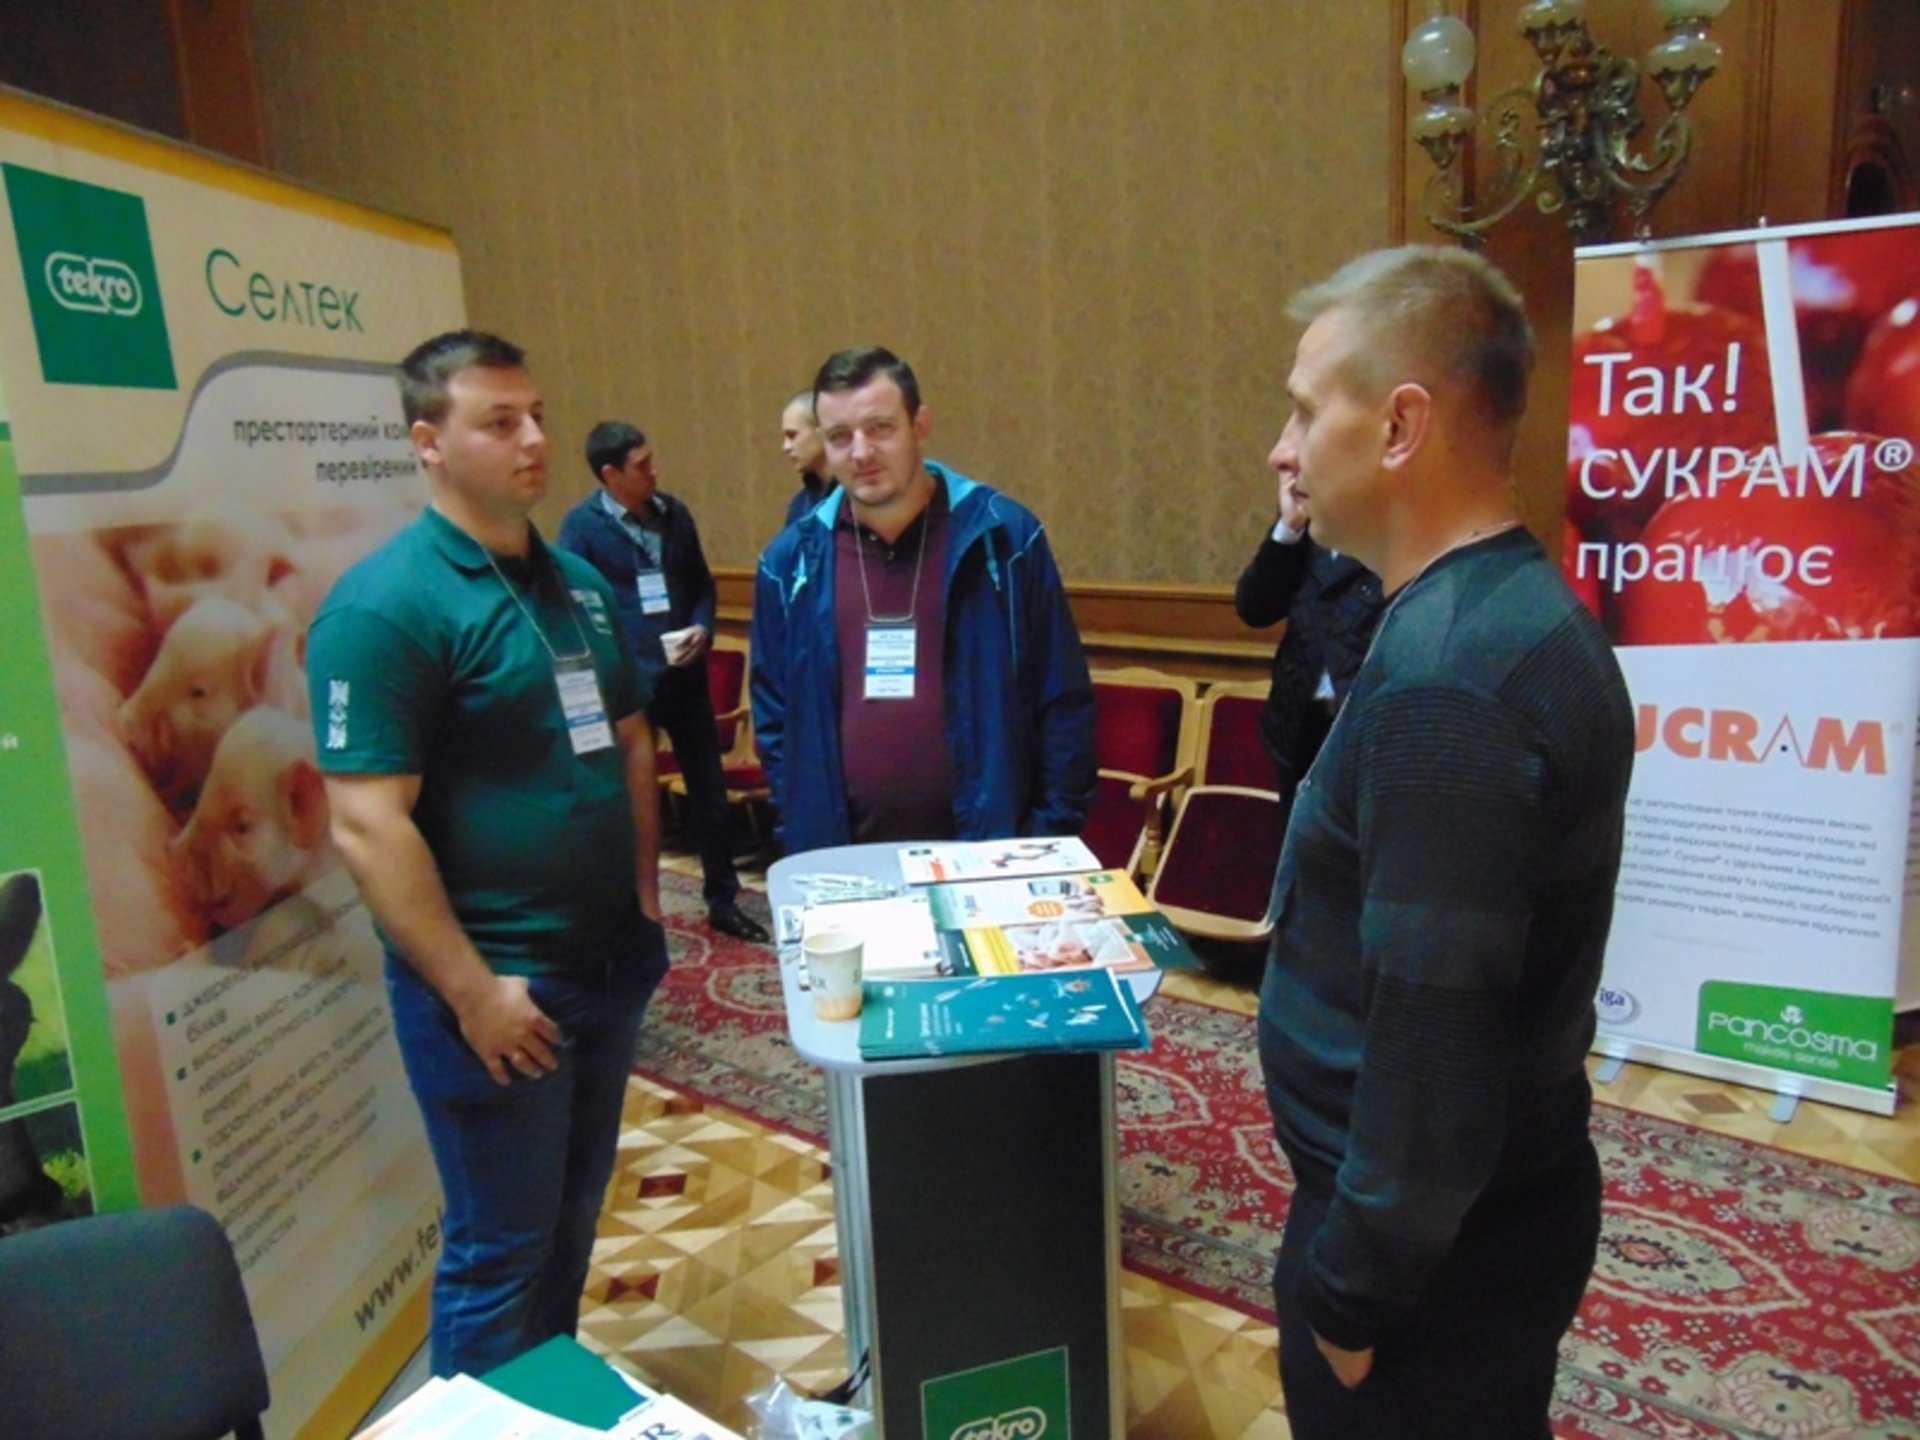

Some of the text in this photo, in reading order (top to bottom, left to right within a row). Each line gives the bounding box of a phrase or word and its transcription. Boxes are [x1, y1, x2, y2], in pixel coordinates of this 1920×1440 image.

[57, 260, 133, 310] tekro
[206, 248, 365, 333] Селтек
[1584, 342, 1741, 418] Так!
[233, 415, 379, 447] престартерний
[316, 452, 418, 487] перевірений
[1576, 539, 1835, 594] працює
